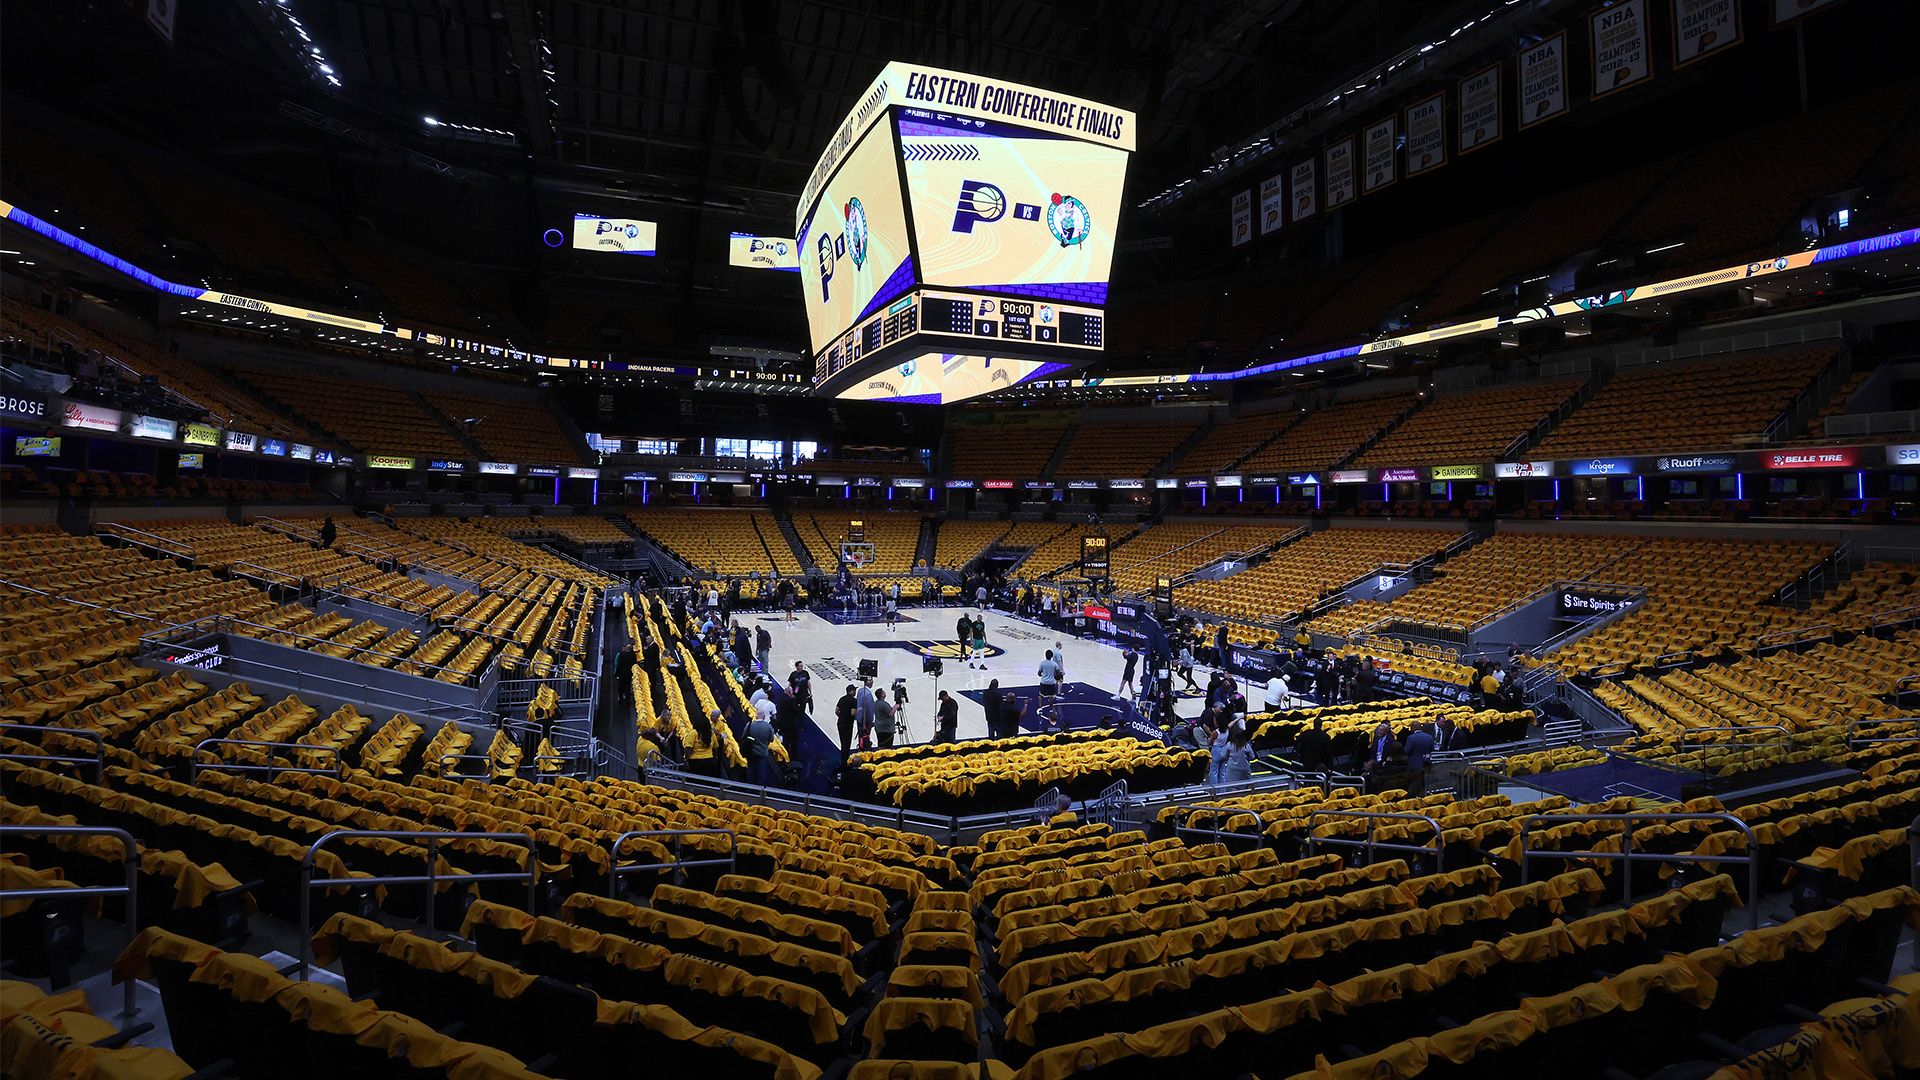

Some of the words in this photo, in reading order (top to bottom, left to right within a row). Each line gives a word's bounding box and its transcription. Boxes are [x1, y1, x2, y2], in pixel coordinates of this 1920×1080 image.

[1601, 7, 1634, 30] NBA
[1681, 0, 1729, 29] CHAMPIONS
[1528, 46, 1555, 66] NBA
[1598, 38, 1641, 63] CHAMPIONS
[1468, 77, 1490, 93] NBA
[1524, 74, 1559, 97] CHAMPIONS
[906, 72, 980, 109] EASTERN
[981, 85, 1076, 128] CONFERENCE
[1076, 106, 1124, 140] FINALS
[1414, 105, 1435, 120] NBA
[1022, 205, 1033, 219] VS
[1858, 233, 1902, 255] PLAYOFFS
[168, 285, 197, 298] PLAYOFFS
[219, 294, 246, 307] EASTERN
[1003, 302, 1031, 315] 90:00
[982, 325, 990, 335] 0
[1042, 331, 1051, 341] 0
[627, 364, 651, 372] INDIANA
[652, 366, 675, 374] PACERS
[755, 371, 777, 381] 90:00
[0, 396, 45, 416] BROSE
[64, 403, 86, 426] Lilly
[192, 429, 219, 445] GAINBRIDGE
[233, 433, 252, 446] IBEW
[371, 456, 410, 465] Koorsen
[1671, 457, 1703, 468] Ruoff
[1785, 455, 1815, 463] BELLE
[1818, 454, 1843, 462] TIRE
[1441, 467, 1480, 477] GAINBRIDGE
[1589, 459, 1615, 474] Kroger
[1085, 538, 1106, 547] 90:00
[1573, 596, 1588, 607] Sire
[1589, 597, 1615, 611] Spirits
[1099, 619, 1107, 632] THE
[204, 656, 222, 670] CLUB
[1131, 721, 1163, 740] coinbase
